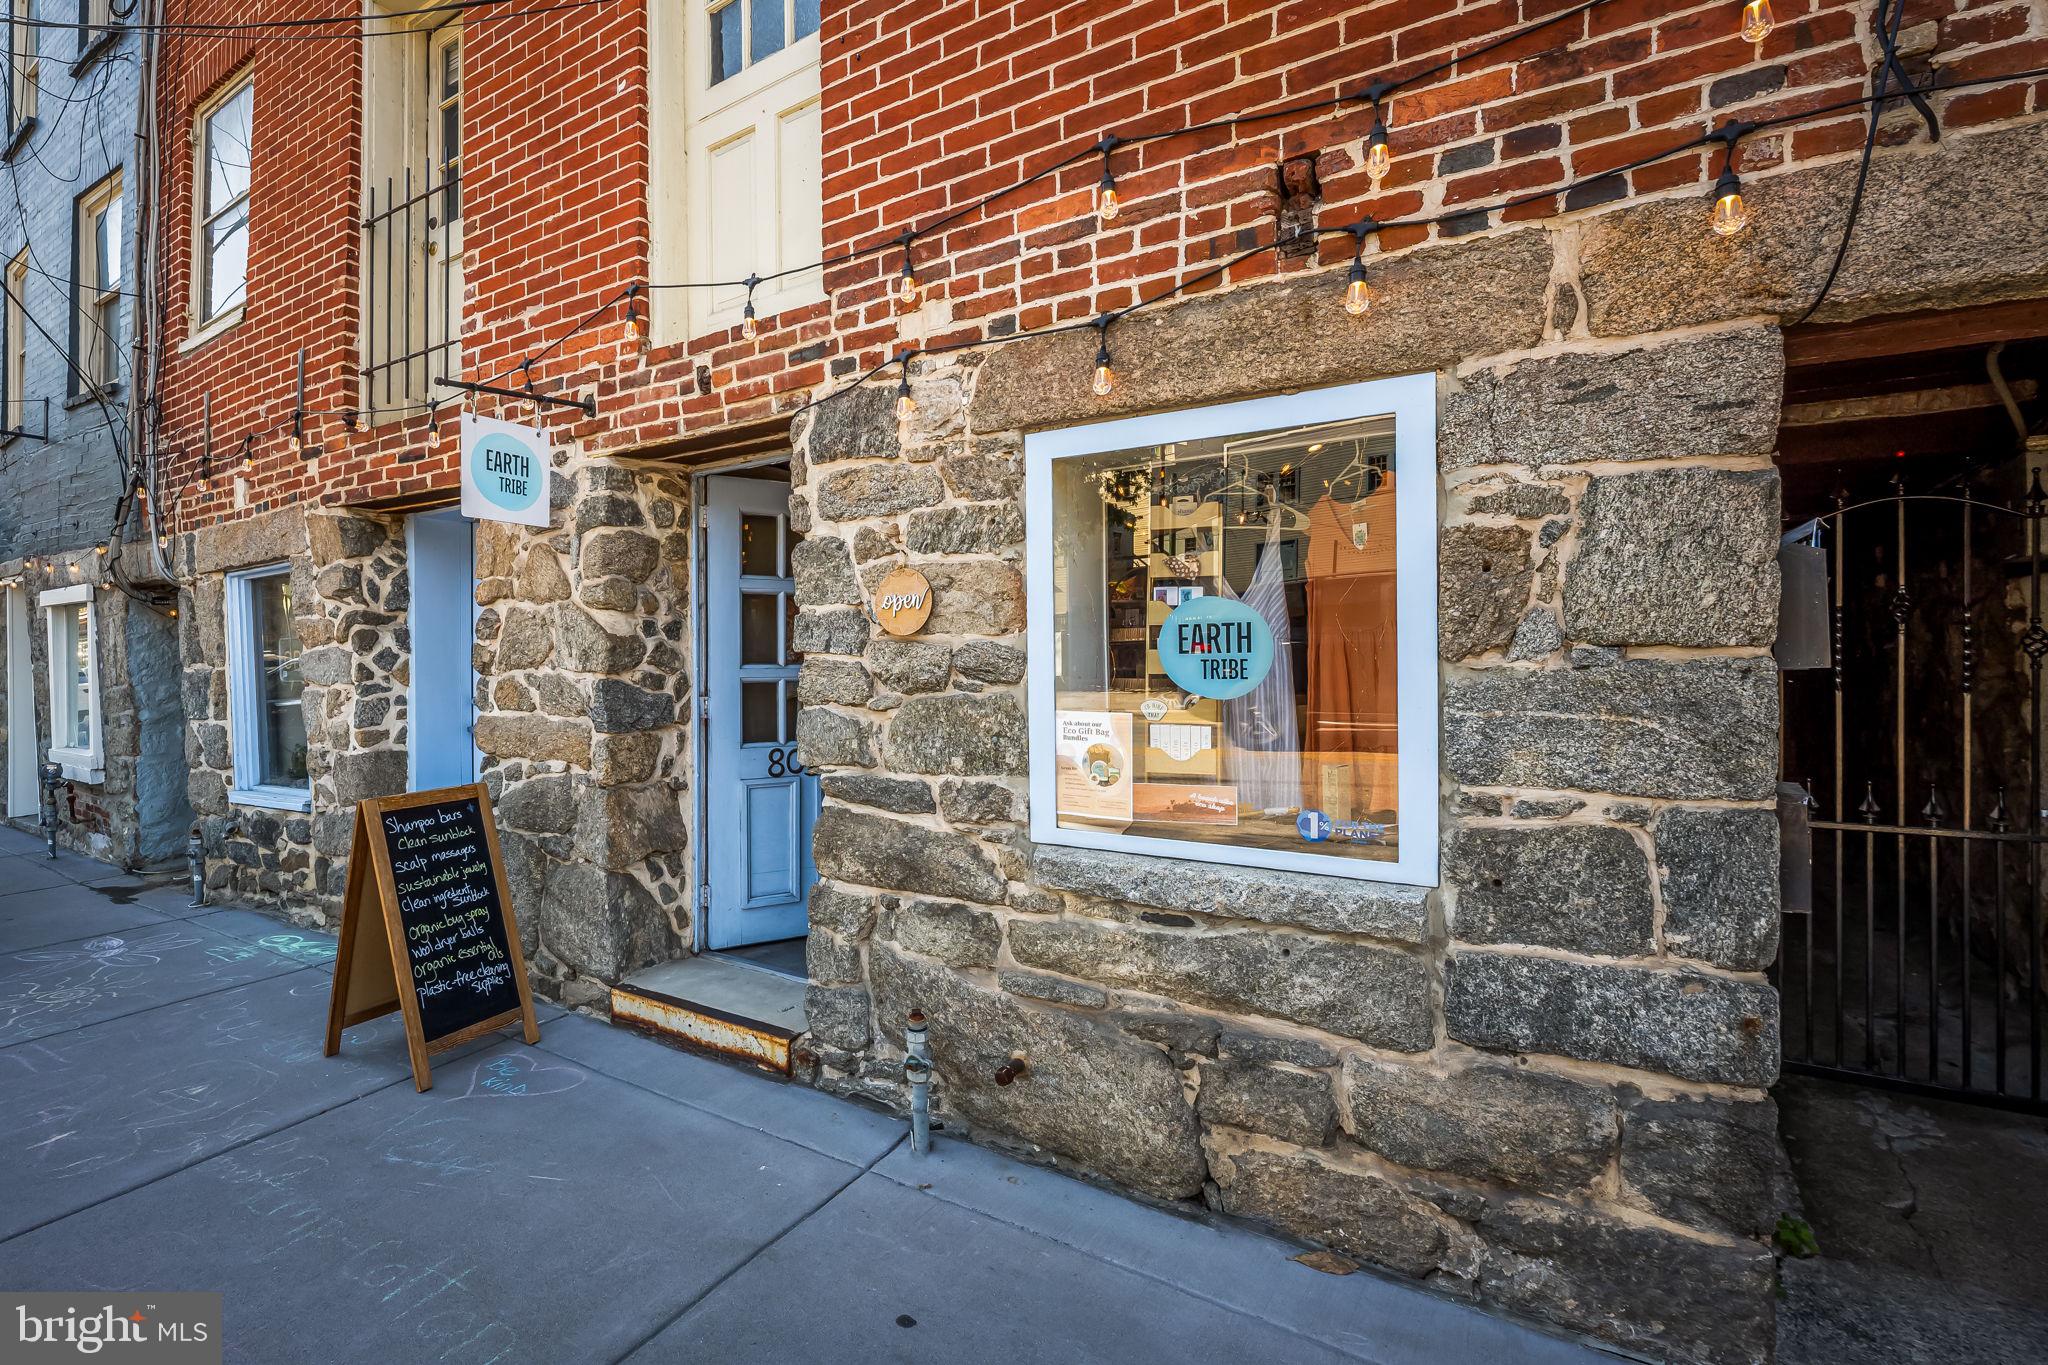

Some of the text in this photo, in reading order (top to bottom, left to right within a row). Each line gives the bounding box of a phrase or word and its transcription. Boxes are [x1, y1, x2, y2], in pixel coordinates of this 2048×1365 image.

[486, 449, 529, 478] EARTH
[499, 476, 528, 497] TRIBE
[881, 585, 930, 618] open
[1178, 622, 1252, 655] EARTH
[1201, 658, 1249, 680] TRIBE
[1095, 729, 1110, 738] Bag
[386, 809, 463, 834] Shampoo bars
[431, 844, 477, 861] massagers
[444, 914, 468, 930] bug
[465, 906, 490, 927] spray
[434, 932, 459, 951] dryer
[460, 925, 485, 939] balls
[458, 936, 498, 959] essential
[476, 962, 512, 978] cleaning
